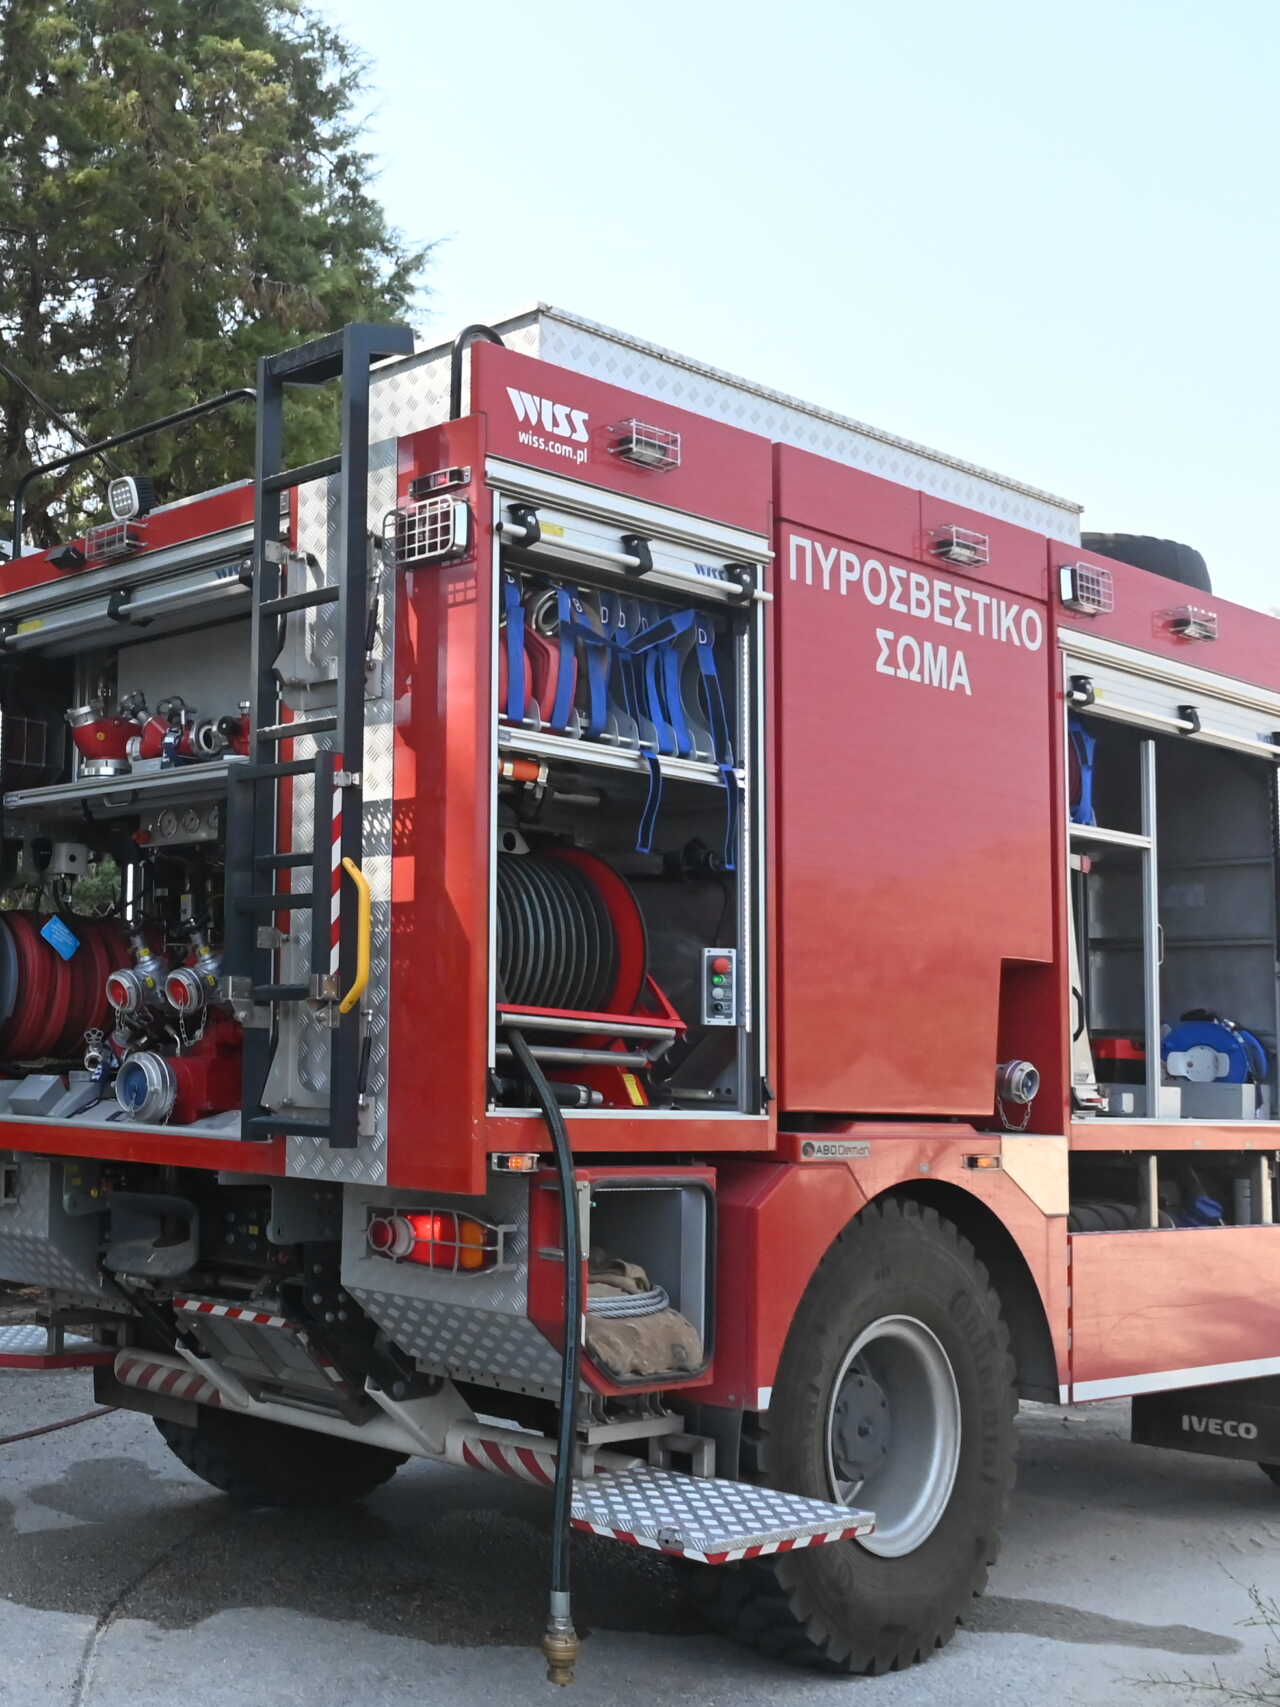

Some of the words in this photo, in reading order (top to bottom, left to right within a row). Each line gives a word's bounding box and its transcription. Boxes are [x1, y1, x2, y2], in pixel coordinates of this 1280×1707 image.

[505, 385, 589, 443] WISS
[518, 430, 588, 464] wiss.com.pl
[789, 534, 1043, 652] ΠΥΡΟΣΒΕΣΤΙΚΟ
[876, 628, 972, 696] ΣΩΜΑ
[1182, 1414, 1258, 1439] IVECO
